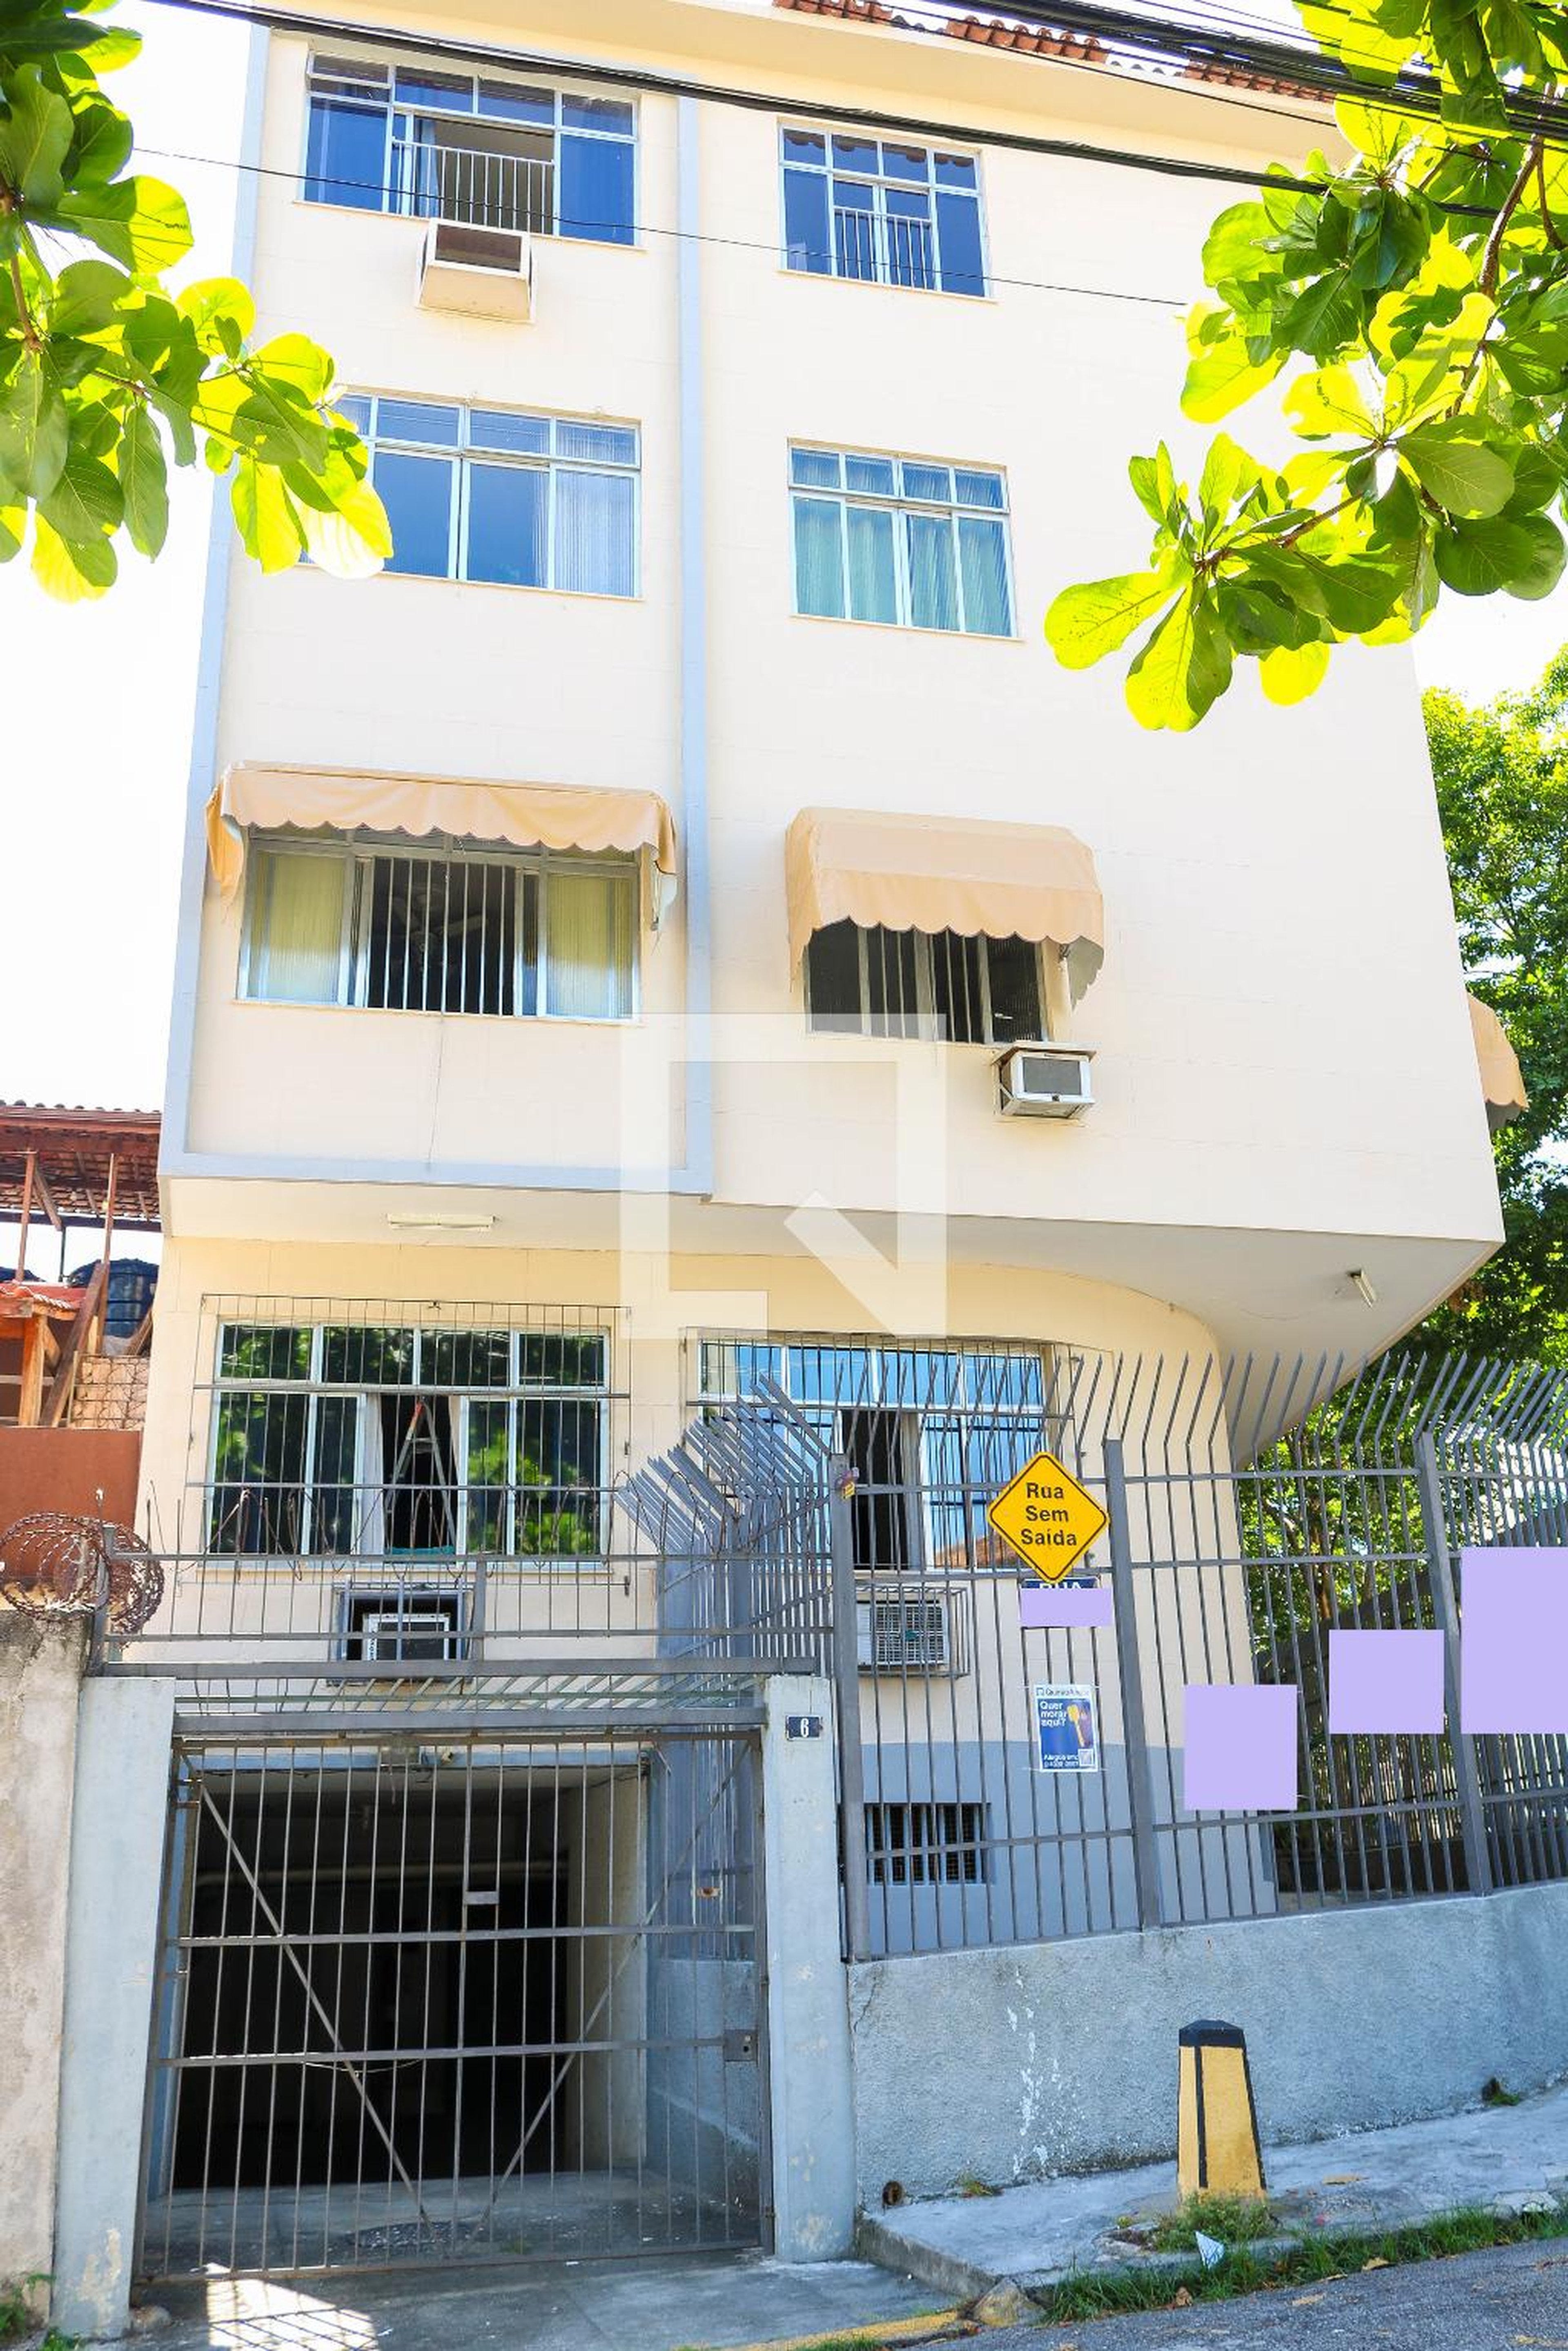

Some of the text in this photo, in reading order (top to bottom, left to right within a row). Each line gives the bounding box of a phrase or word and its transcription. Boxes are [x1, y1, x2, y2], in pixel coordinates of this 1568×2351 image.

[1027, 1482, 1064, 1499] Rua
[1025, 1505, 1069, 1522] Sem
[1021, 1528, 1077, 1546] Saída
[1040, 1701, 1063, 1710] Quer
[800, 1718, 809, 1738] 6
